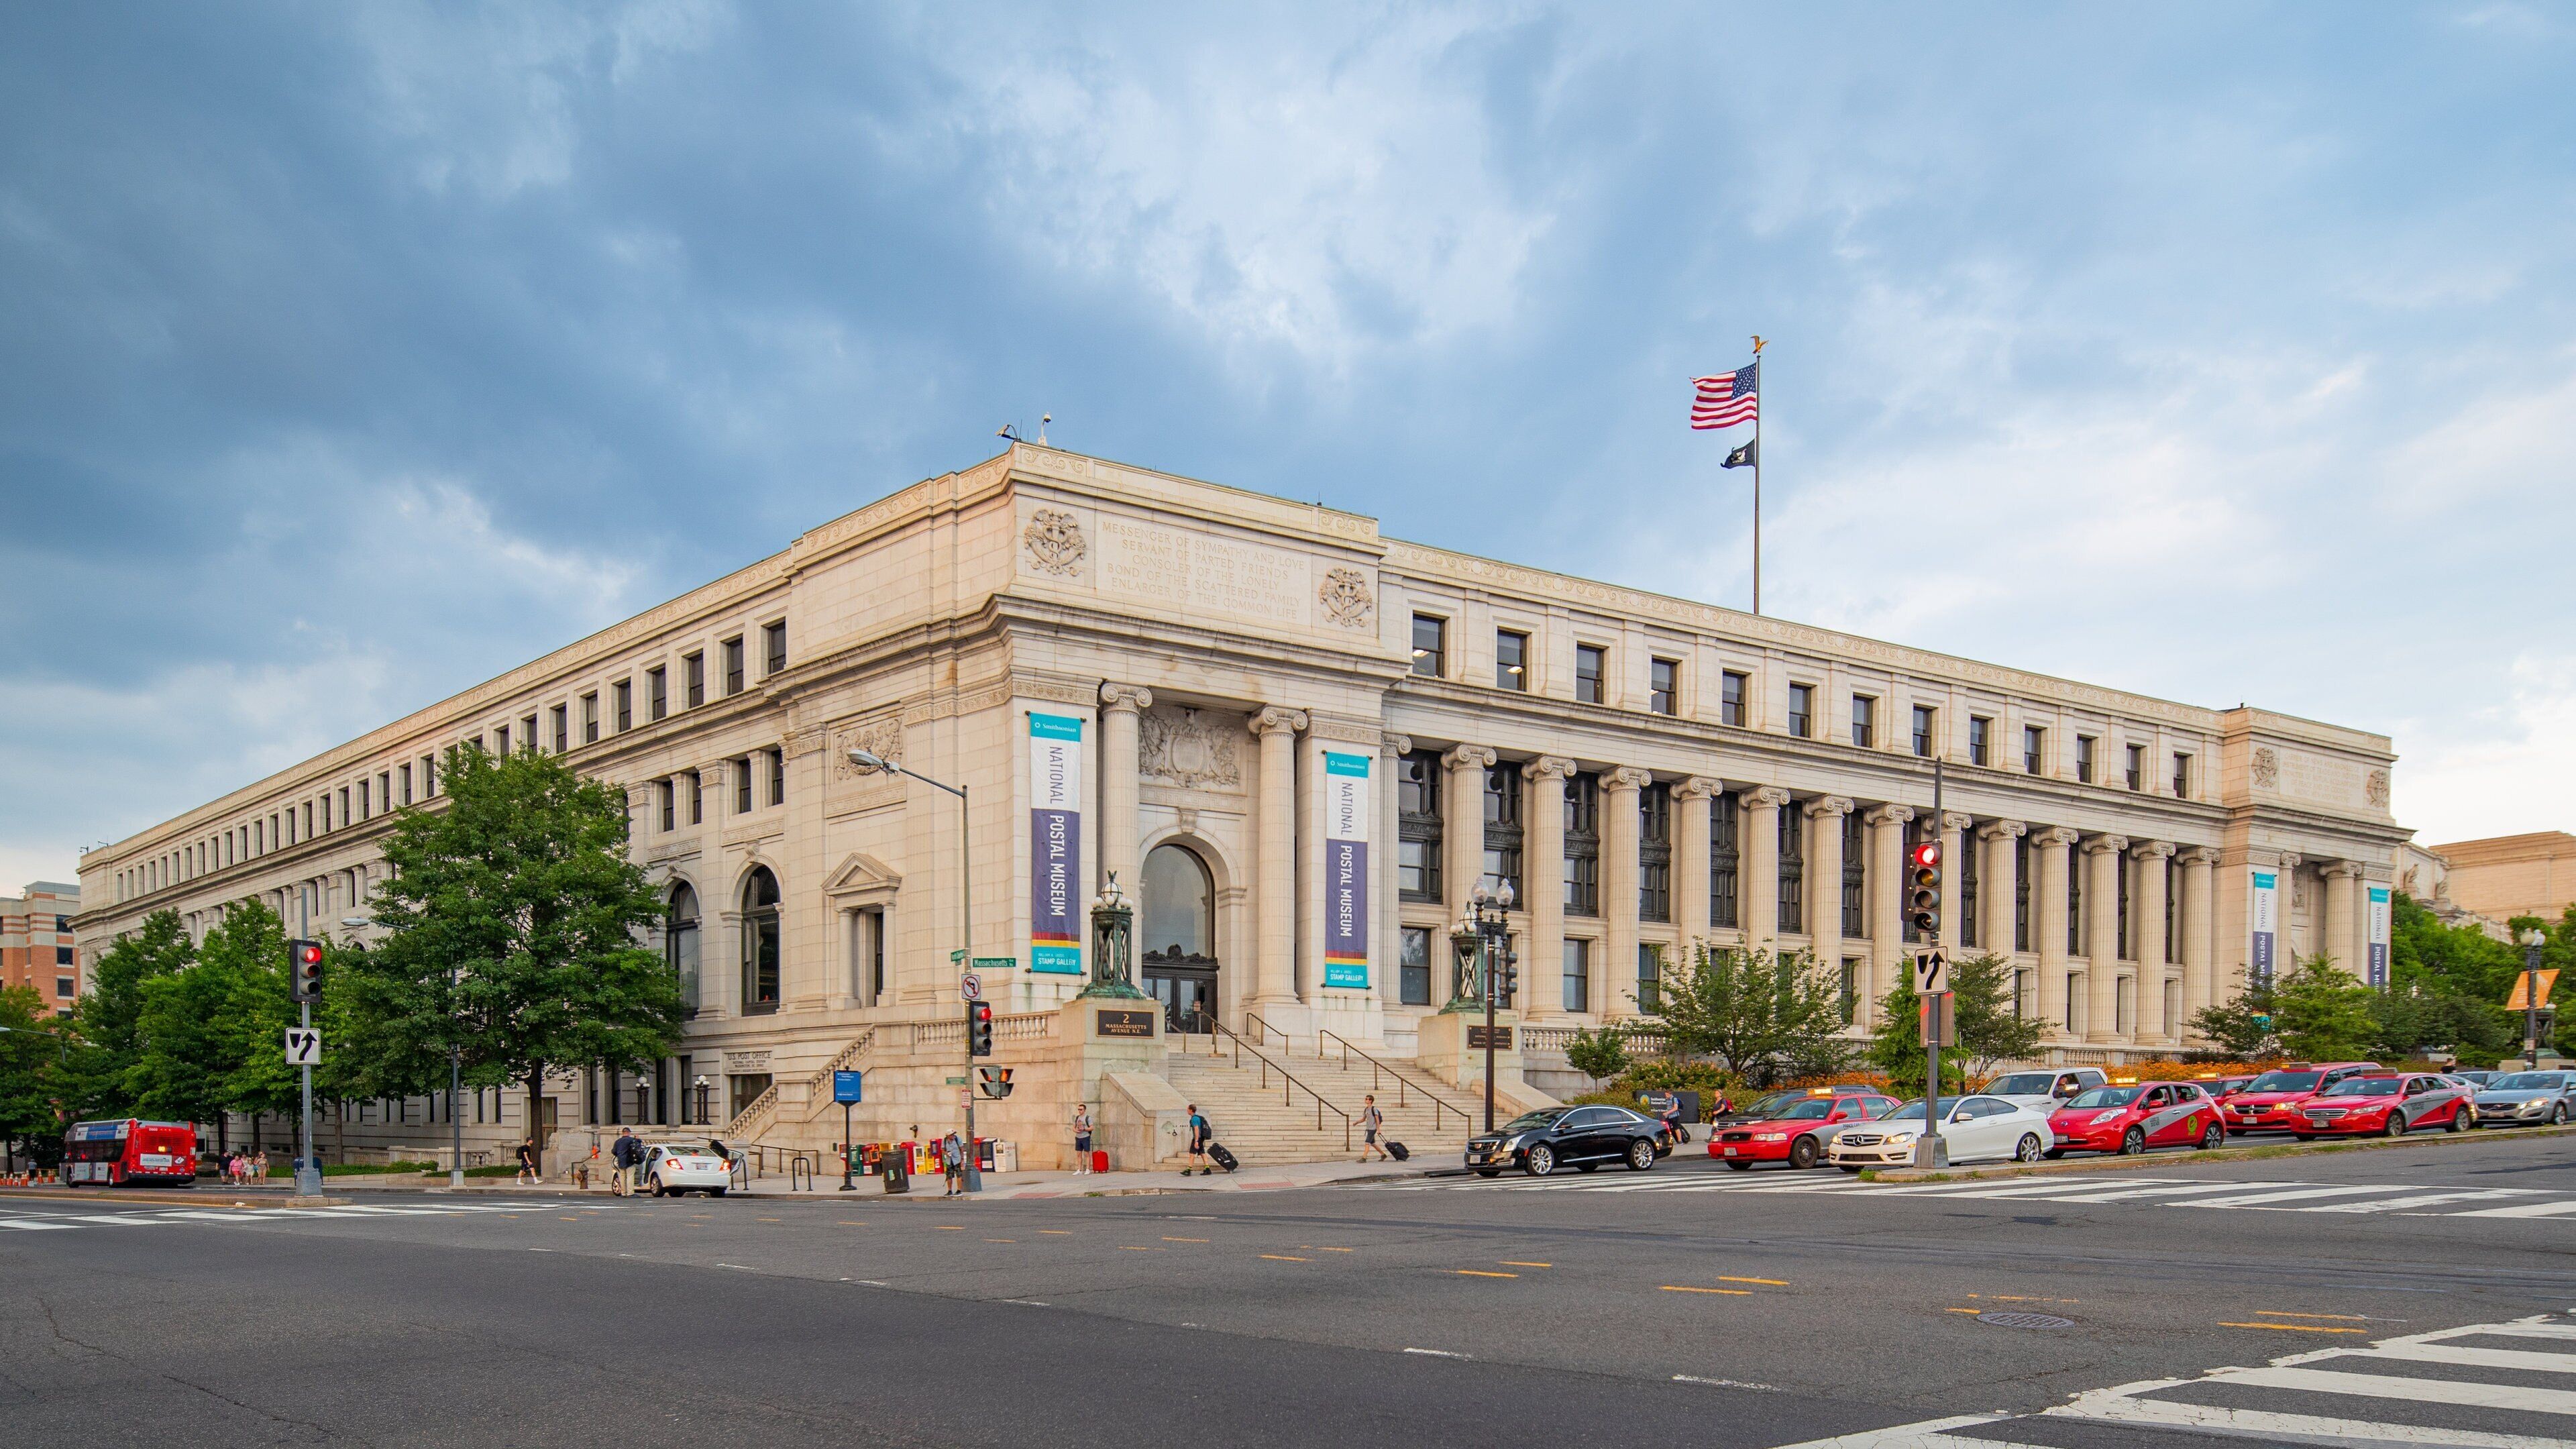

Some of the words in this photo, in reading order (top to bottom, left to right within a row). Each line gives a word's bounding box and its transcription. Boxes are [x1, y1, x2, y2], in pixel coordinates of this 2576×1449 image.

[1102, 521, 1171, 545] MESSENGER
[1176, 536, 1190, 547] OF
[1194, 540, 1248, 559] SYMPATHY
[1253, 551, 1275, 565] AND
[1279, 556, 1304, 570] LOVE
[1122, 539, 1172, 557] SERVANT
[1176, 550, 1190, 561] OF
[1195, 553, 1235, 569] PARTED
[1242, 562, 1288, 580] FRIENDS
[1108, 563, 1139, 577] BOND
[1147, 570, 1161, 581] OF
[1167, 574, 1187, 586] THE
[1195, 579, 1258, 599] SCATTERED
[1265, 592, 1301, 607] FAMILY
[1133, 555, 1192, 574] CONSOLER
[1197, 567, 1211, 577] OF
[1215, 570, 1235, 582] THE
[1241, 575, 1279, 591] LONELY
[1112, 577, 1171, 597] ENLARGER
[1177, 589, 1192, 600] OF
[1197, 592, 1217, 605] THE
[1223, 597, 1271, 613] COMMON
[1277, 605, 1297, 619] LIFE
[1042, 723, 1076, 732] Smithsonian
[1050, 746, 1064, 804] NATIONAL
[1341, 783, 1353, 835] NATIONAL
[1050, 815, 1065, 859] POSTAL
[1340, 845, 1352, 885] POSTAL
[1050, 863, 1065, 916] MUSEUM
[1340, 889, 1352, 937] MUSEUM
[1123, 1014, 1129, 1023] 2
